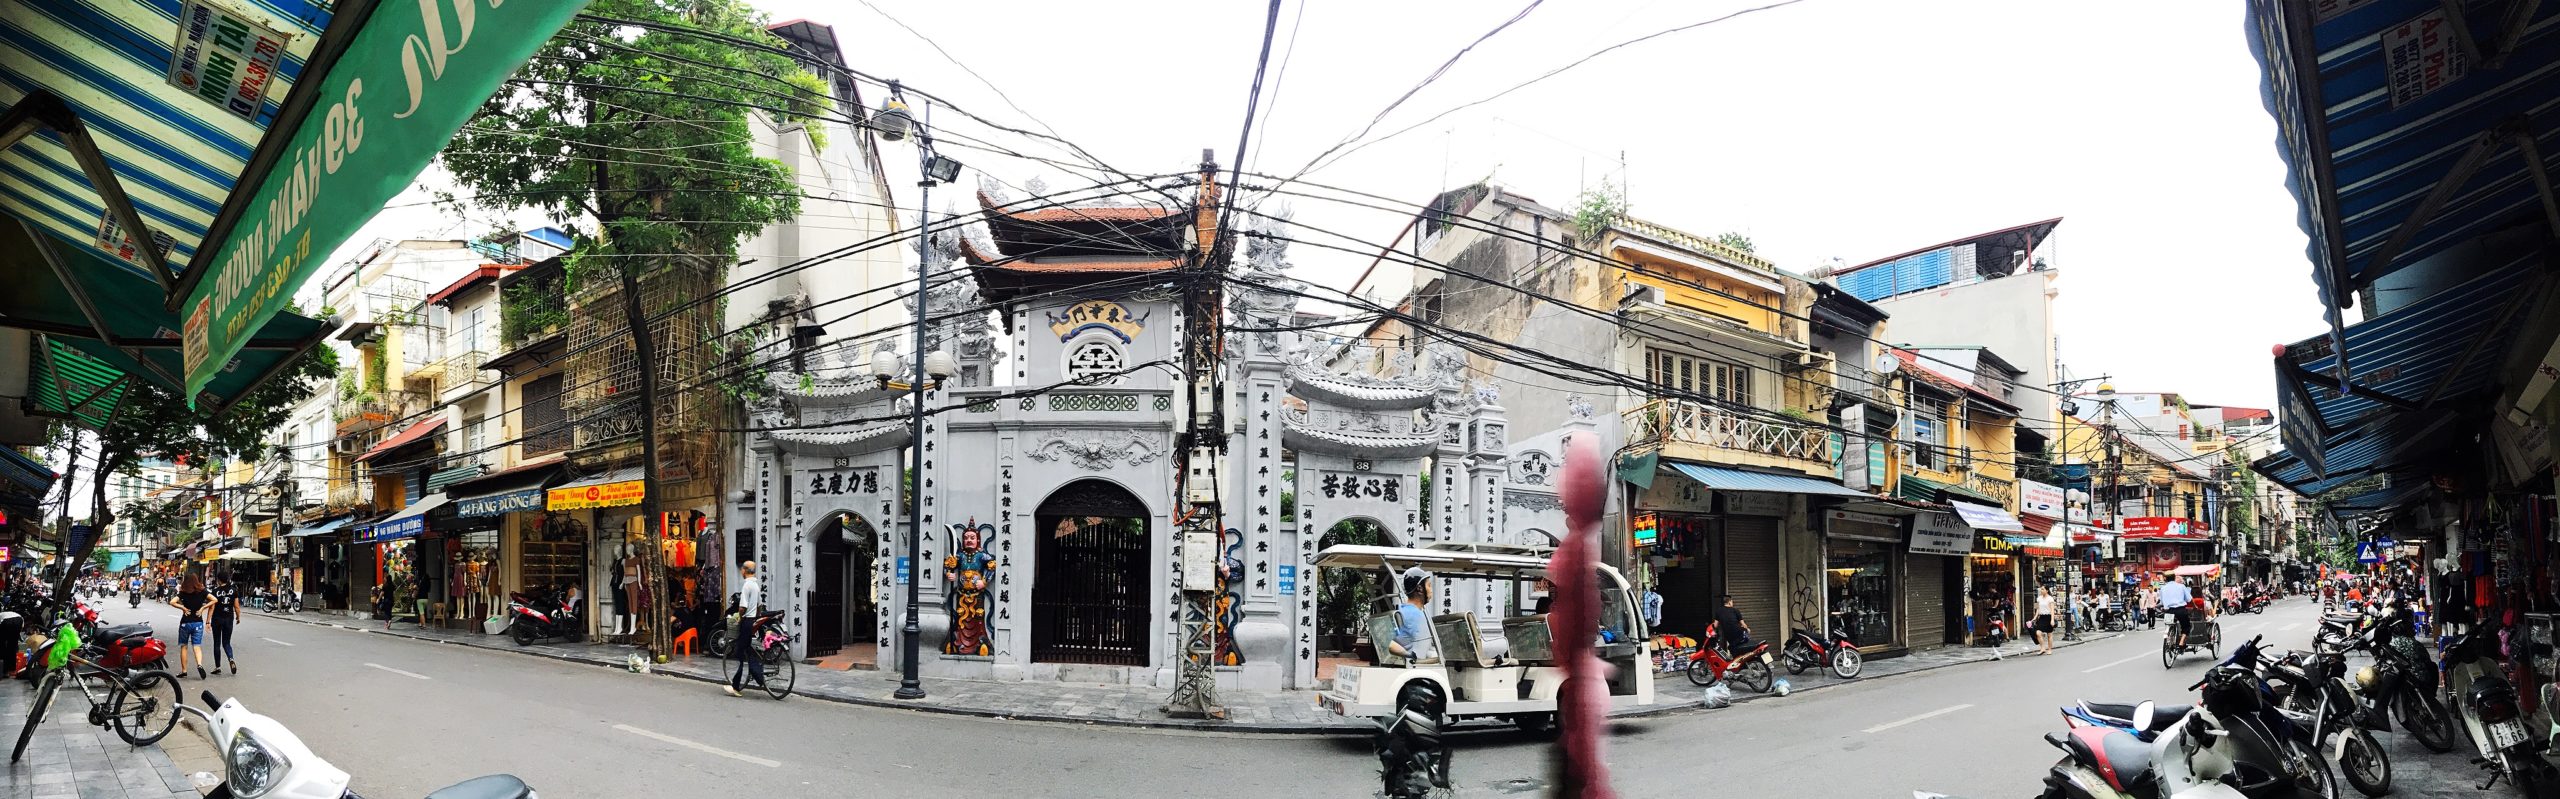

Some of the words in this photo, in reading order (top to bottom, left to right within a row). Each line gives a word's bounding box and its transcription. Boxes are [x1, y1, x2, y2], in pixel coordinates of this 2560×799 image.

[211, 15, 250, 54] TÀI
[2422, 18, 2444, 49] An
[199, 51, 237, 104] MINH
[836, 458, 848, 467] 38
[1356, 461, 1370, 471] 38
[588, 489, 598, 499] 42
[460, 504, 472, 515] 44
[1982, 536, 2014, 551] TOMA
